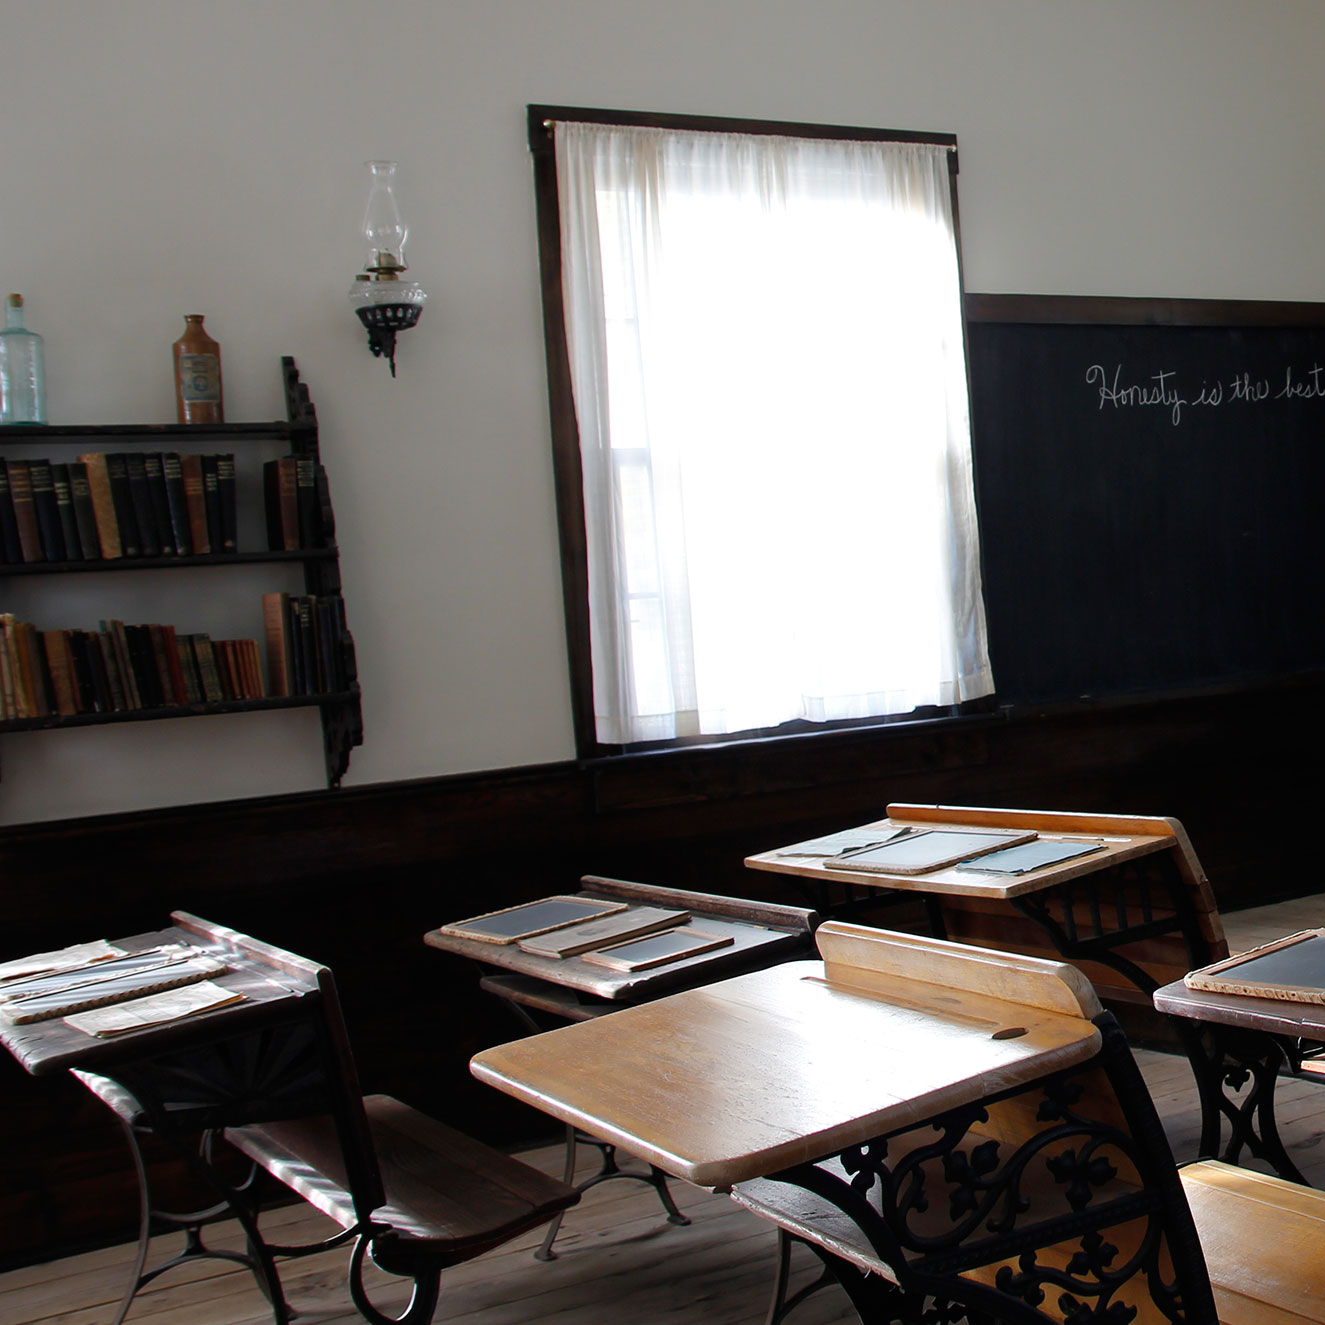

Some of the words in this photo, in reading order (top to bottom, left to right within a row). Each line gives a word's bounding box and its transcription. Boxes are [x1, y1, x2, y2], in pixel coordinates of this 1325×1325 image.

[1086, 364, 1187, 426] Honesty
[1192, 381, 1222, 406] is
[1229, 373, 1269, 402] the
[1277, 362, 1325, 399] best
